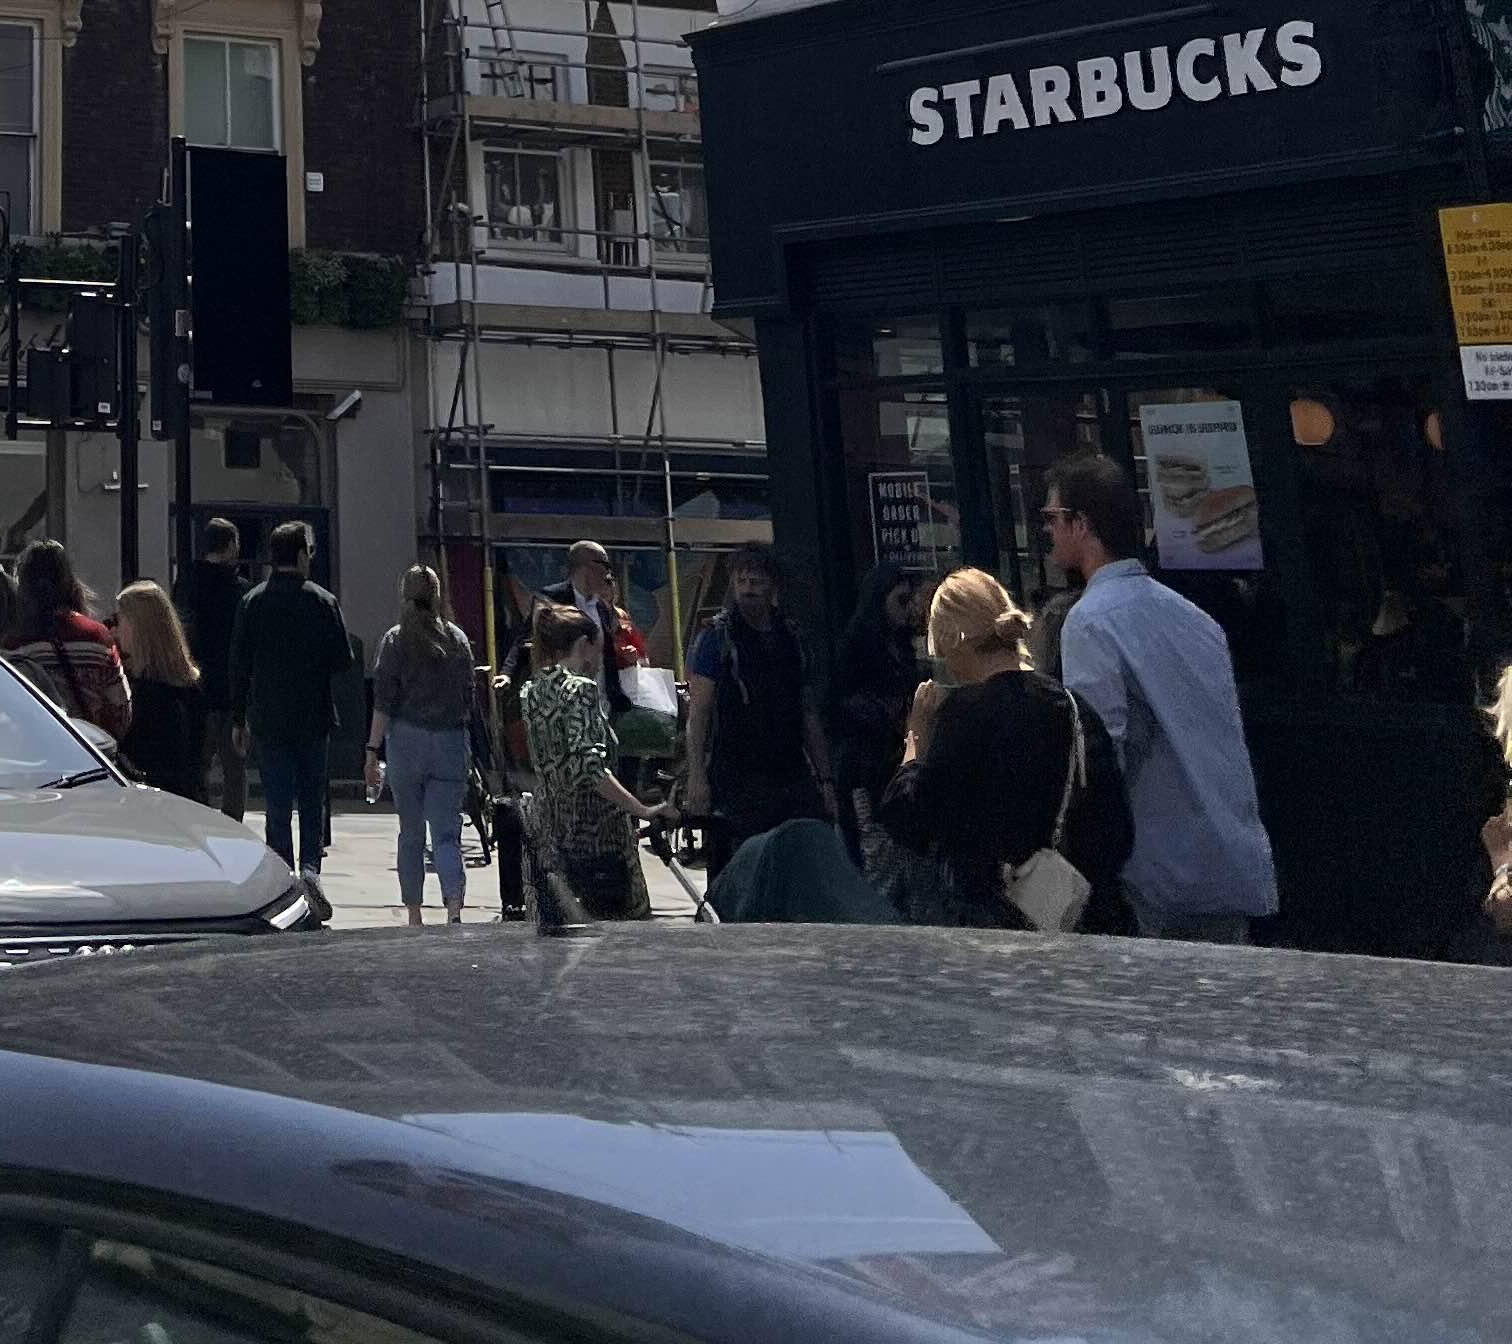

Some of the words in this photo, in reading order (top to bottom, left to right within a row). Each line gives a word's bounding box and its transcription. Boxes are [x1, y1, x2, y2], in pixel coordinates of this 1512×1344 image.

[909, 20, 1322, 146] STARBUCKS
[878, 482, 922, 499] MOBILE
[882, 504, 921, 520] ORDER
